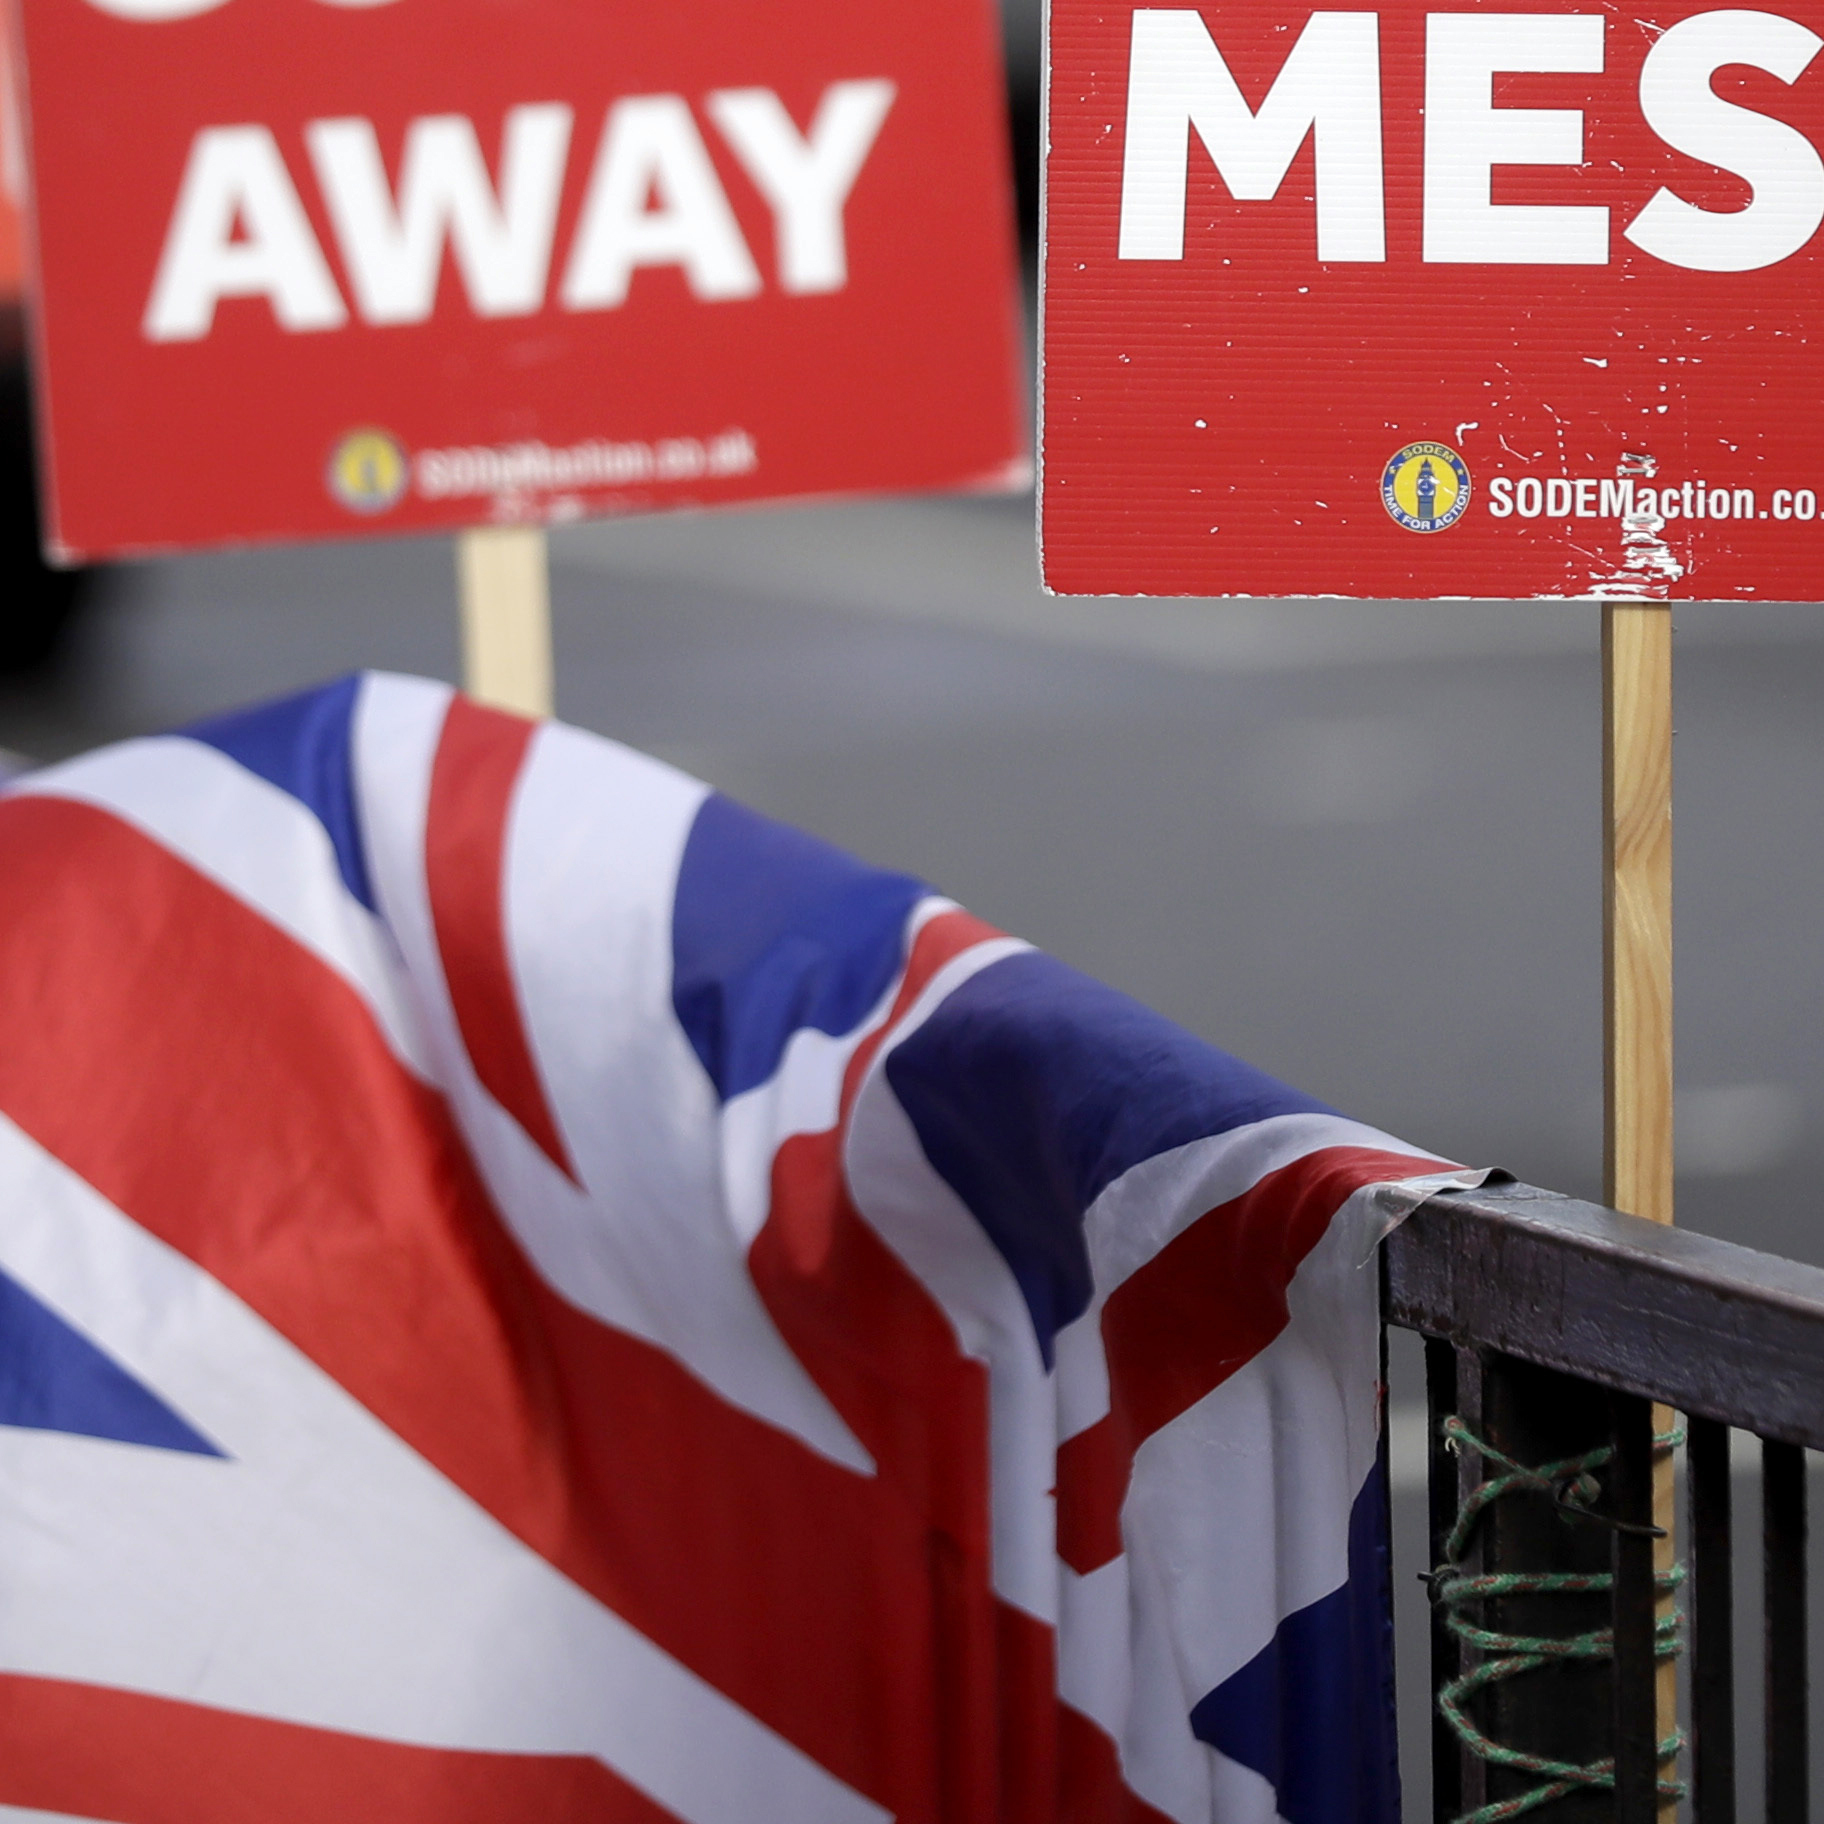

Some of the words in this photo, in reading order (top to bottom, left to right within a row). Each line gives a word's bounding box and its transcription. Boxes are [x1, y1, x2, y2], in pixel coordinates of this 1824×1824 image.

[146, 81, 894, 341] AWAY
[1402, 444, 1455, 463] SODEM
[1384, 484, 1403, 518] TIME
[1402, 515, 1431, 530] FOR
[1434, 484, 1469, 529] ACTION
